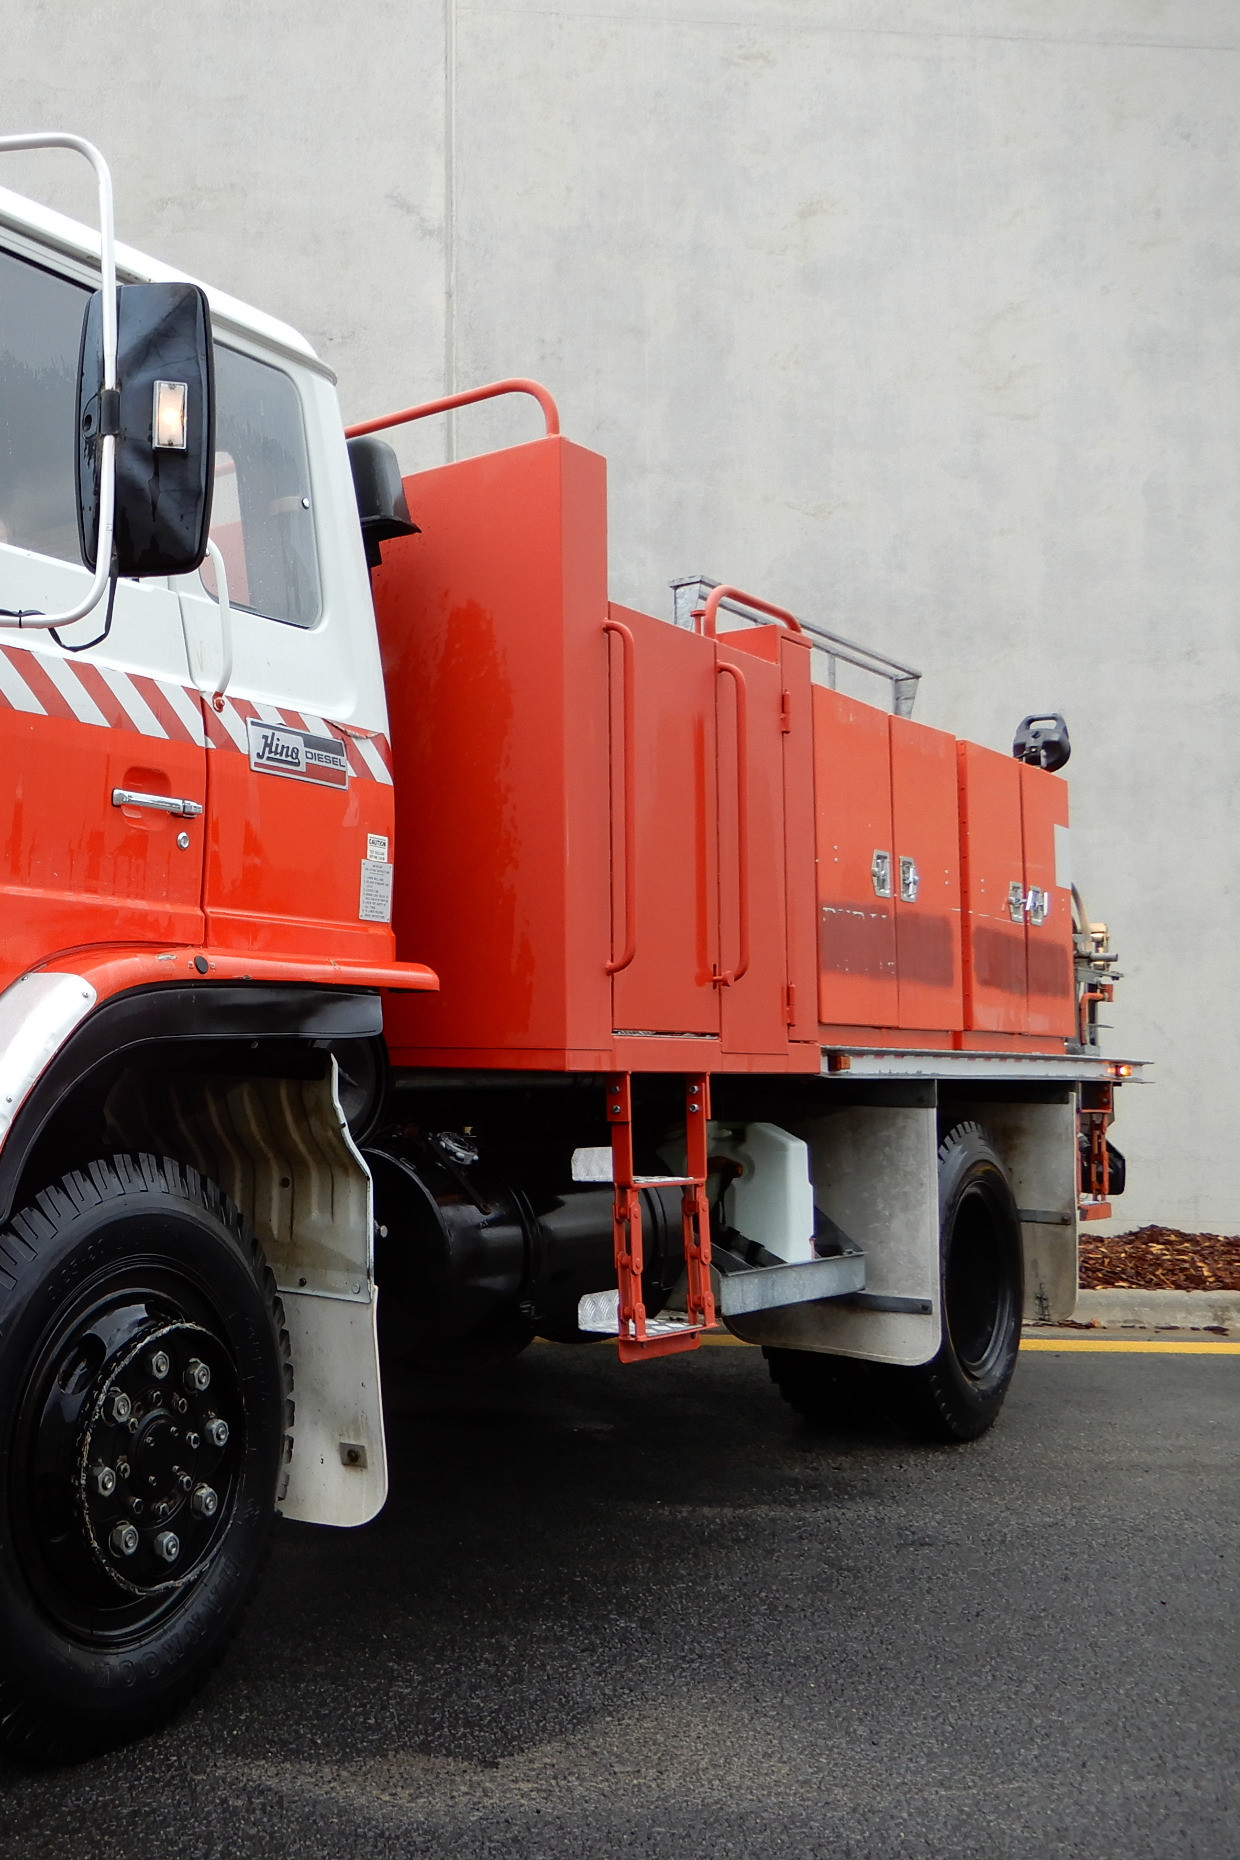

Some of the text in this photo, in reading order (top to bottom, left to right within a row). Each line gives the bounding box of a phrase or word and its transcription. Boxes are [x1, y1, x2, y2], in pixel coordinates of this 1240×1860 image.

[256, 732, 346, 768] Hino DIESEL
[369, 838, 387, 847] CAUTION
[93, 1555, 241, 1689] HANKOOK
